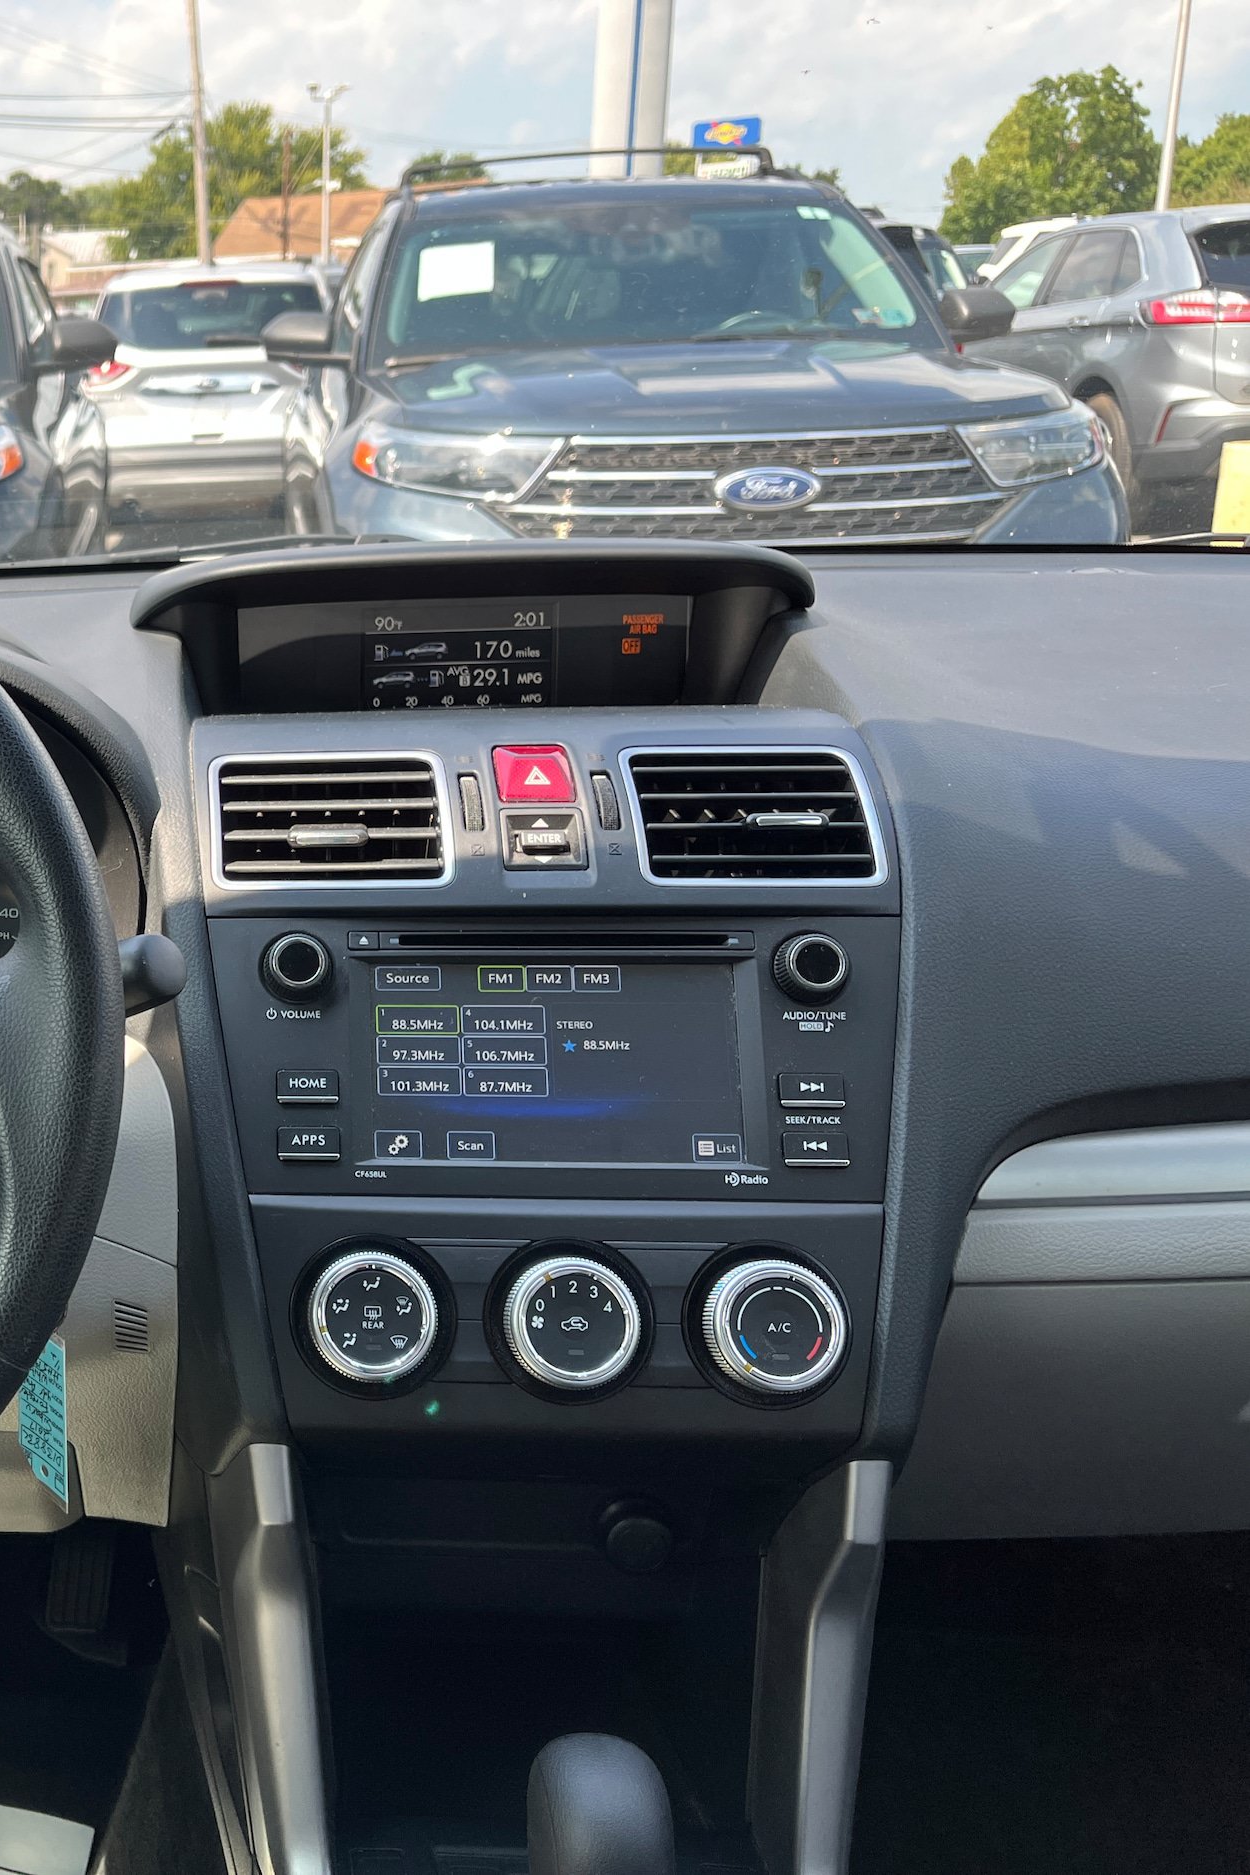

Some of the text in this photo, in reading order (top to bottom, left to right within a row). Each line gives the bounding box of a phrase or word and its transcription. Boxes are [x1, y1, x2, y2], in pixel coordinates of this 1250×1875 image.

[740, 475, 798, 500] Ford
[513, 611, 546, 628] 2:01
[622, 614, 664, 625] PASSENGER
[474, 640, 541, 660] 170 miles
[622, 639, 640, 654] OFF
[447, 666, 469, 677] AVG
[473, 668, 543, 688] 29.1 MPG
[405, 696, 418, 708] 20
[476, 694, 490, 706] 60
[520, 693, 542, 704] MPG
[527, 833, 562, 844] ENTER
[386, 973, 430, 984] Source
[488, 973, 513, 984] FM1
[535, 973, 562, 984] FM2
[583, 974, 610, 984] FM3
[280, 1010, 321, 1019] VOLUME
[782, 1011, 847, 1021] AUDIO/TUNE
[391, 1019, 444, 1031] 88.5MHz
[474, 1019, 534, 1031] 104.1MHz
[556, 1021, 593, 1030] STEREO
[583, 1040, 631, 1051] 88.5MHz
[392, 1050, 445, 1062] 97.3MHz
[475, 1050, 535, 1062] 106.7MHz
[289, 1077, 327, 1089] HOME
[390, 1080, 450, 1092] 101.3MHz
[479, 1081, 533, 1093] 87.7MHz
[785, 1116, 841, 1125] SEEK/TRACK
[291, 1134, 326, 1146] APPS
[457, 1140, 484, 1151] Scan
[716, 1143, 737, 1154] List
[740, 1174, 769, 1186] Radio
[550, 1285, 556, 1299] 1
[568, 1280, 578, 1294] 2
[589, 1285, 599, 1299] 3
[535, 1298, 545, 1312] 0
[603, 1300, 613, 1313] 4
[362, 1321, 385, 1330] REAR
[767, 1322, 791, 1333] A/C
